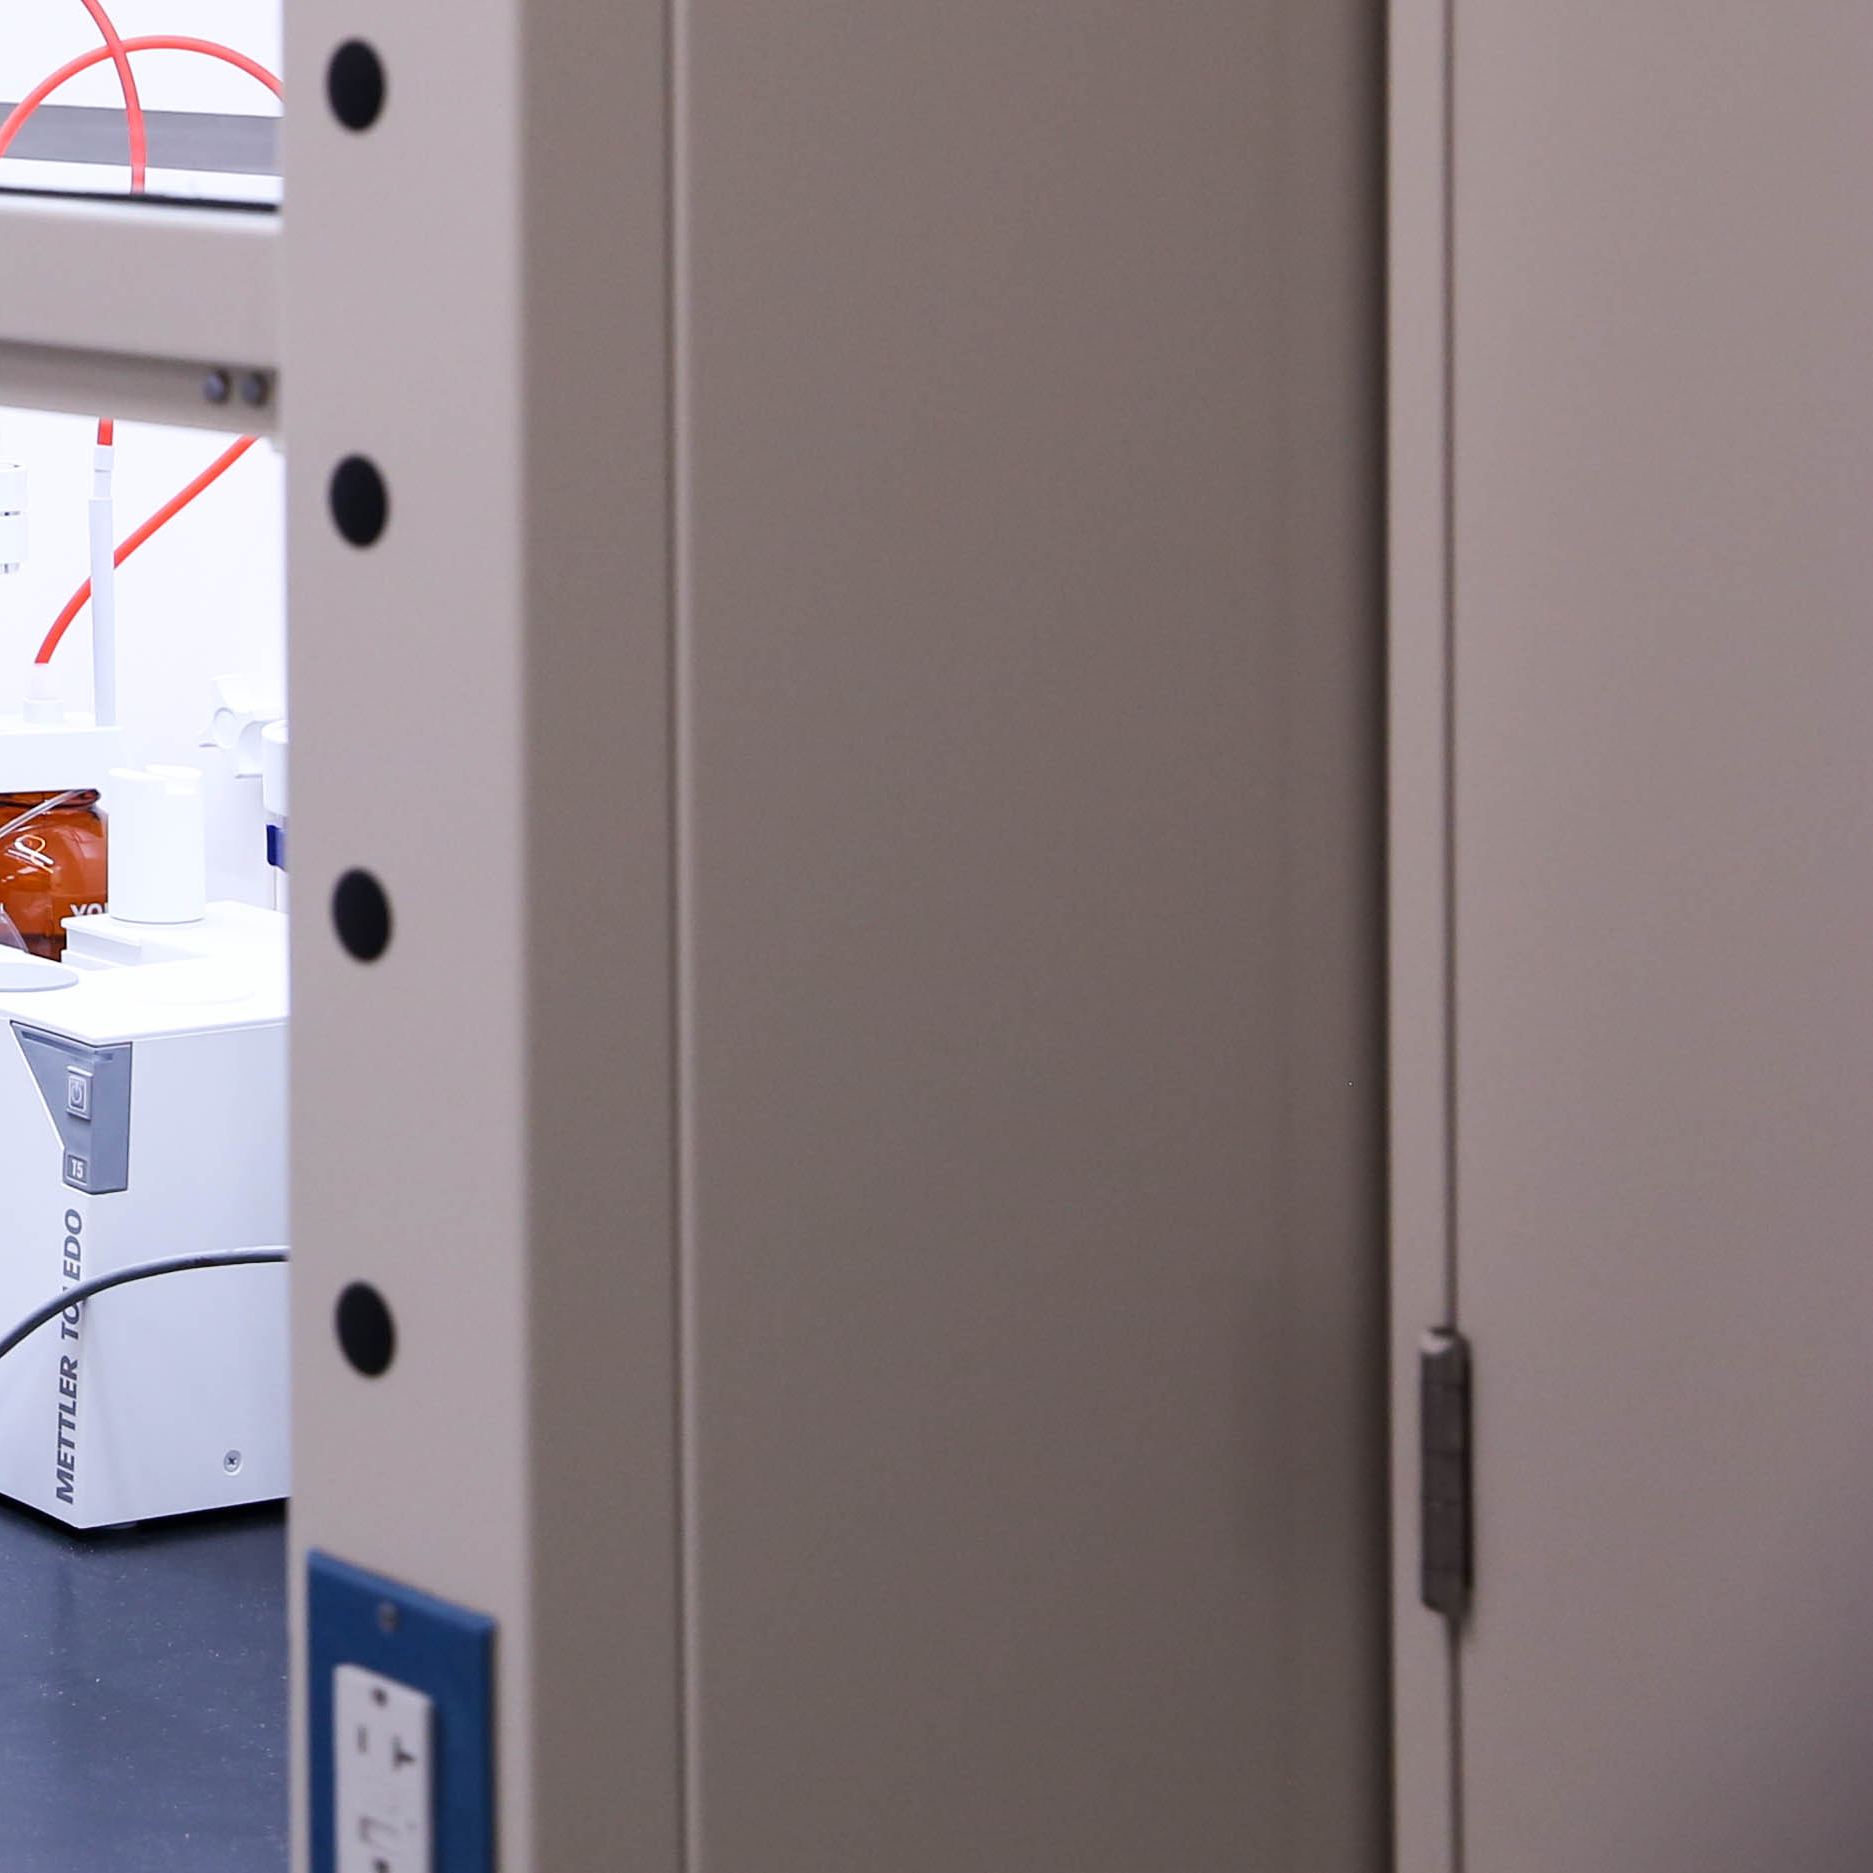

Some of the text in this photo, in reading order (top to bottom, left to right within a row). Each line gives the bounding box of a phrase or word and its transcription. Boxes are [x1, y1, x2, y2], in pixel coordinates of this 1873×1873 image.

[70, 1159, 84, 1179] T5
[56, 1208, 83, 1505] METTLER TOEDO
